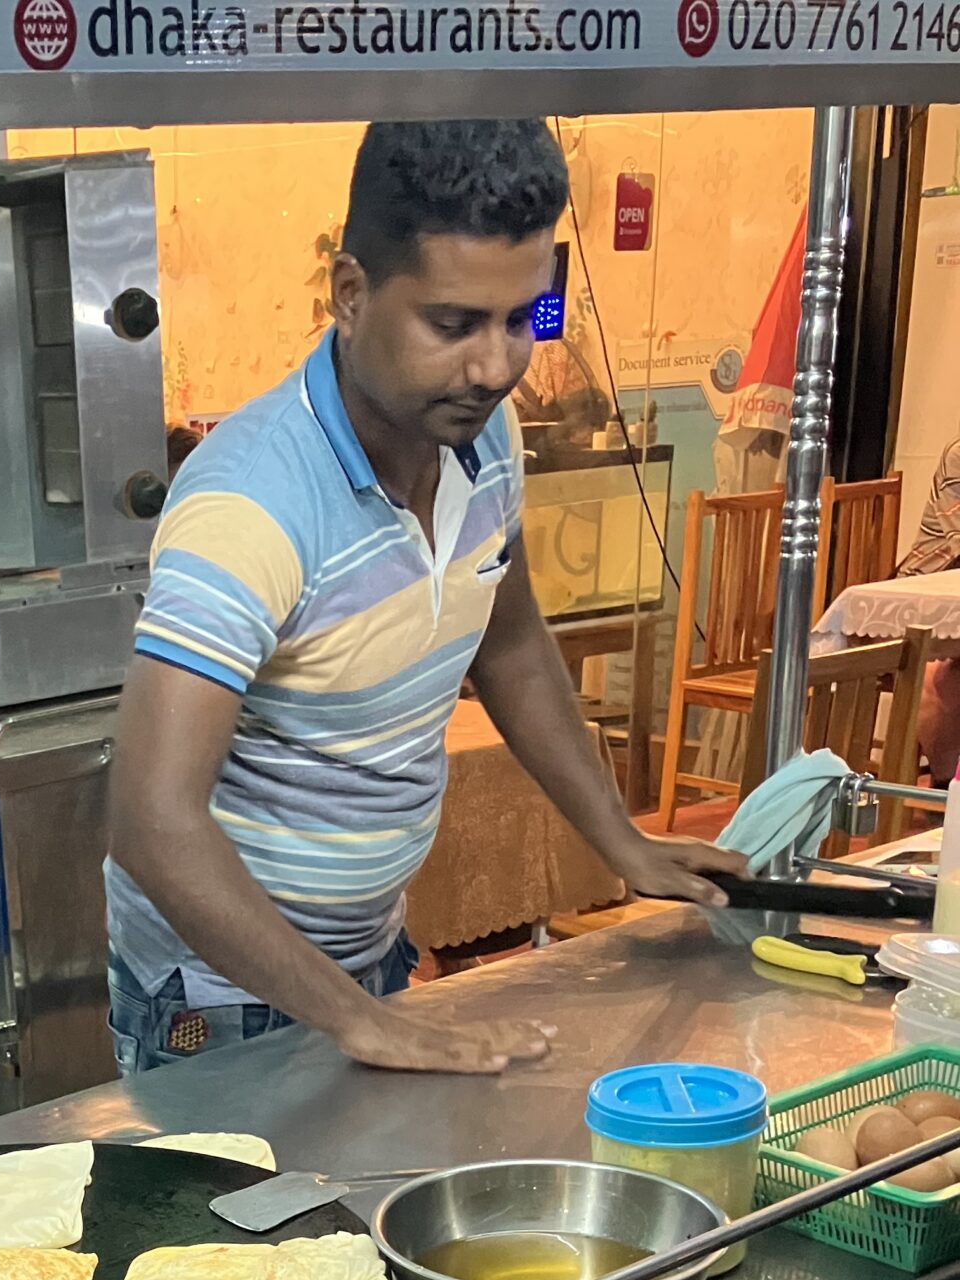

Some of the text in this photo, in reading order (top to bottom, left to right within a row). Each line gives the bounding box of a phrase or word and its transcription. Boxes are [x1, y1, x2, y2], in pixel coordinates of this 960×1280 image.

[87, 0, 641, 57] dhaka-restaurants.com
[728, 0, 797, 50] 020
[805, 1, 882, 51] 7761
[619, 207, 645, 223] OPEN
[618, 351, 711, 372] Document service
